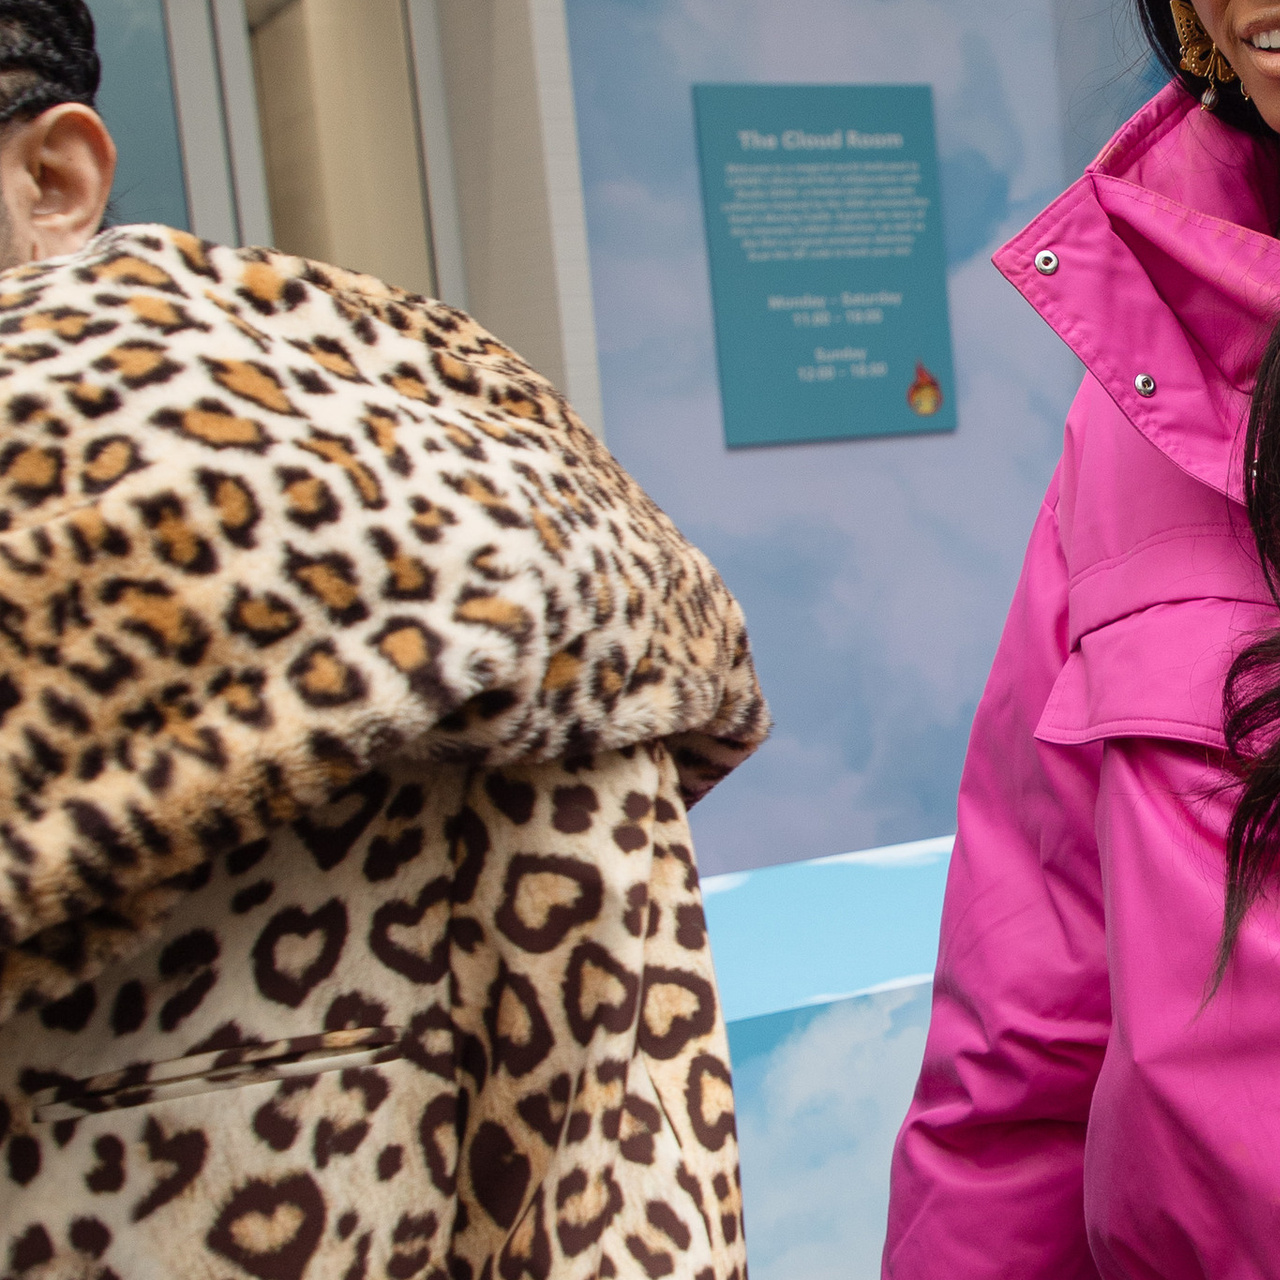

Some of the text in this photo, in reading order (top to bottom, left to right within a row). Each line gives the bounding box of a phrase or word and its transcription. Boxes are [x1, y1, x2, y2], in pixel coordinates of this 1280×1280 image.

[738, 129, 904, 150] The Cloud Room
